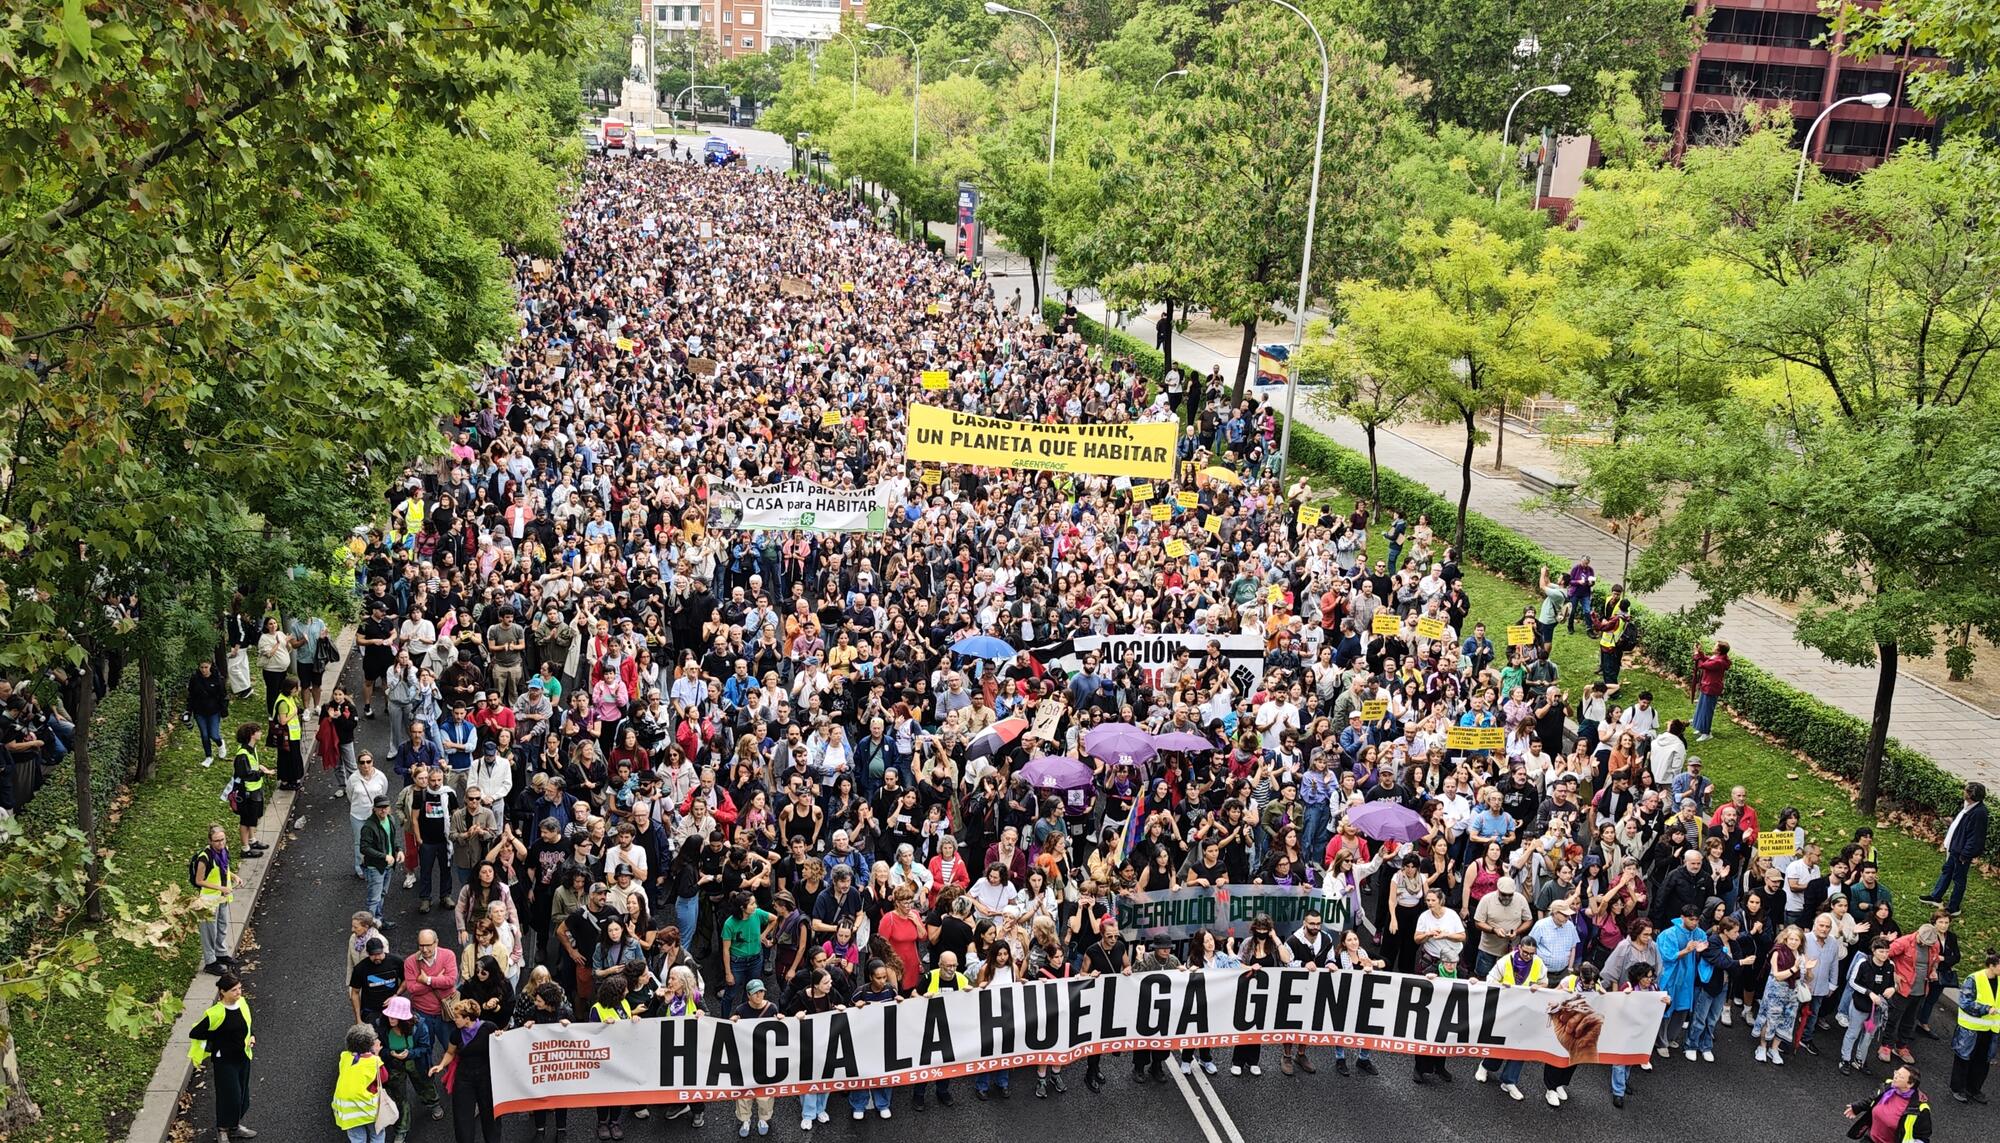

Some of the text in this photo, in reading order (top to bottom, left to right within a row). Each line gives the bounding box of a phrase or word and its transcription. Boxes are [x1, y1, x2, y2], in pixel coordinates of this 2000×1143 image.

[917, 428, 1167, 463] UN PLANETA QUE HABITAR
[1011, 459, 1068, 470] GREENPEACE
[720, 497, 877, 513] una CASA para HABITAR
[660, 970, 1506, 1086] HACIA LA HUELGA GENERAL
[532, 1039, 590, 1050] SINDICATO
[532, 1049, 608, 1063] DE INQUILINAS
[532, 1061, 600, 1074] E INQUILINOS
[679, 1089, 756, 1100] BAJADA
[765, 1085, 800, 1096] DEL
[808, 1075, 901, 1092] ALQUILER
[909, 1067, 943, 1082] 50%
[965, 1043, 1095, 1073] EXPROPIACIÓN
[1101, 1039, 1172, 1052] FONDOS
[1179, 1035, 1240, 1047] BUITRE
[1261, 1033, 1366, 1047] CONTRATOS
[1373, 1039, 1491, 1056] INDEFINIDOS
[532, 1071, 590, 1085] DE MADRID
